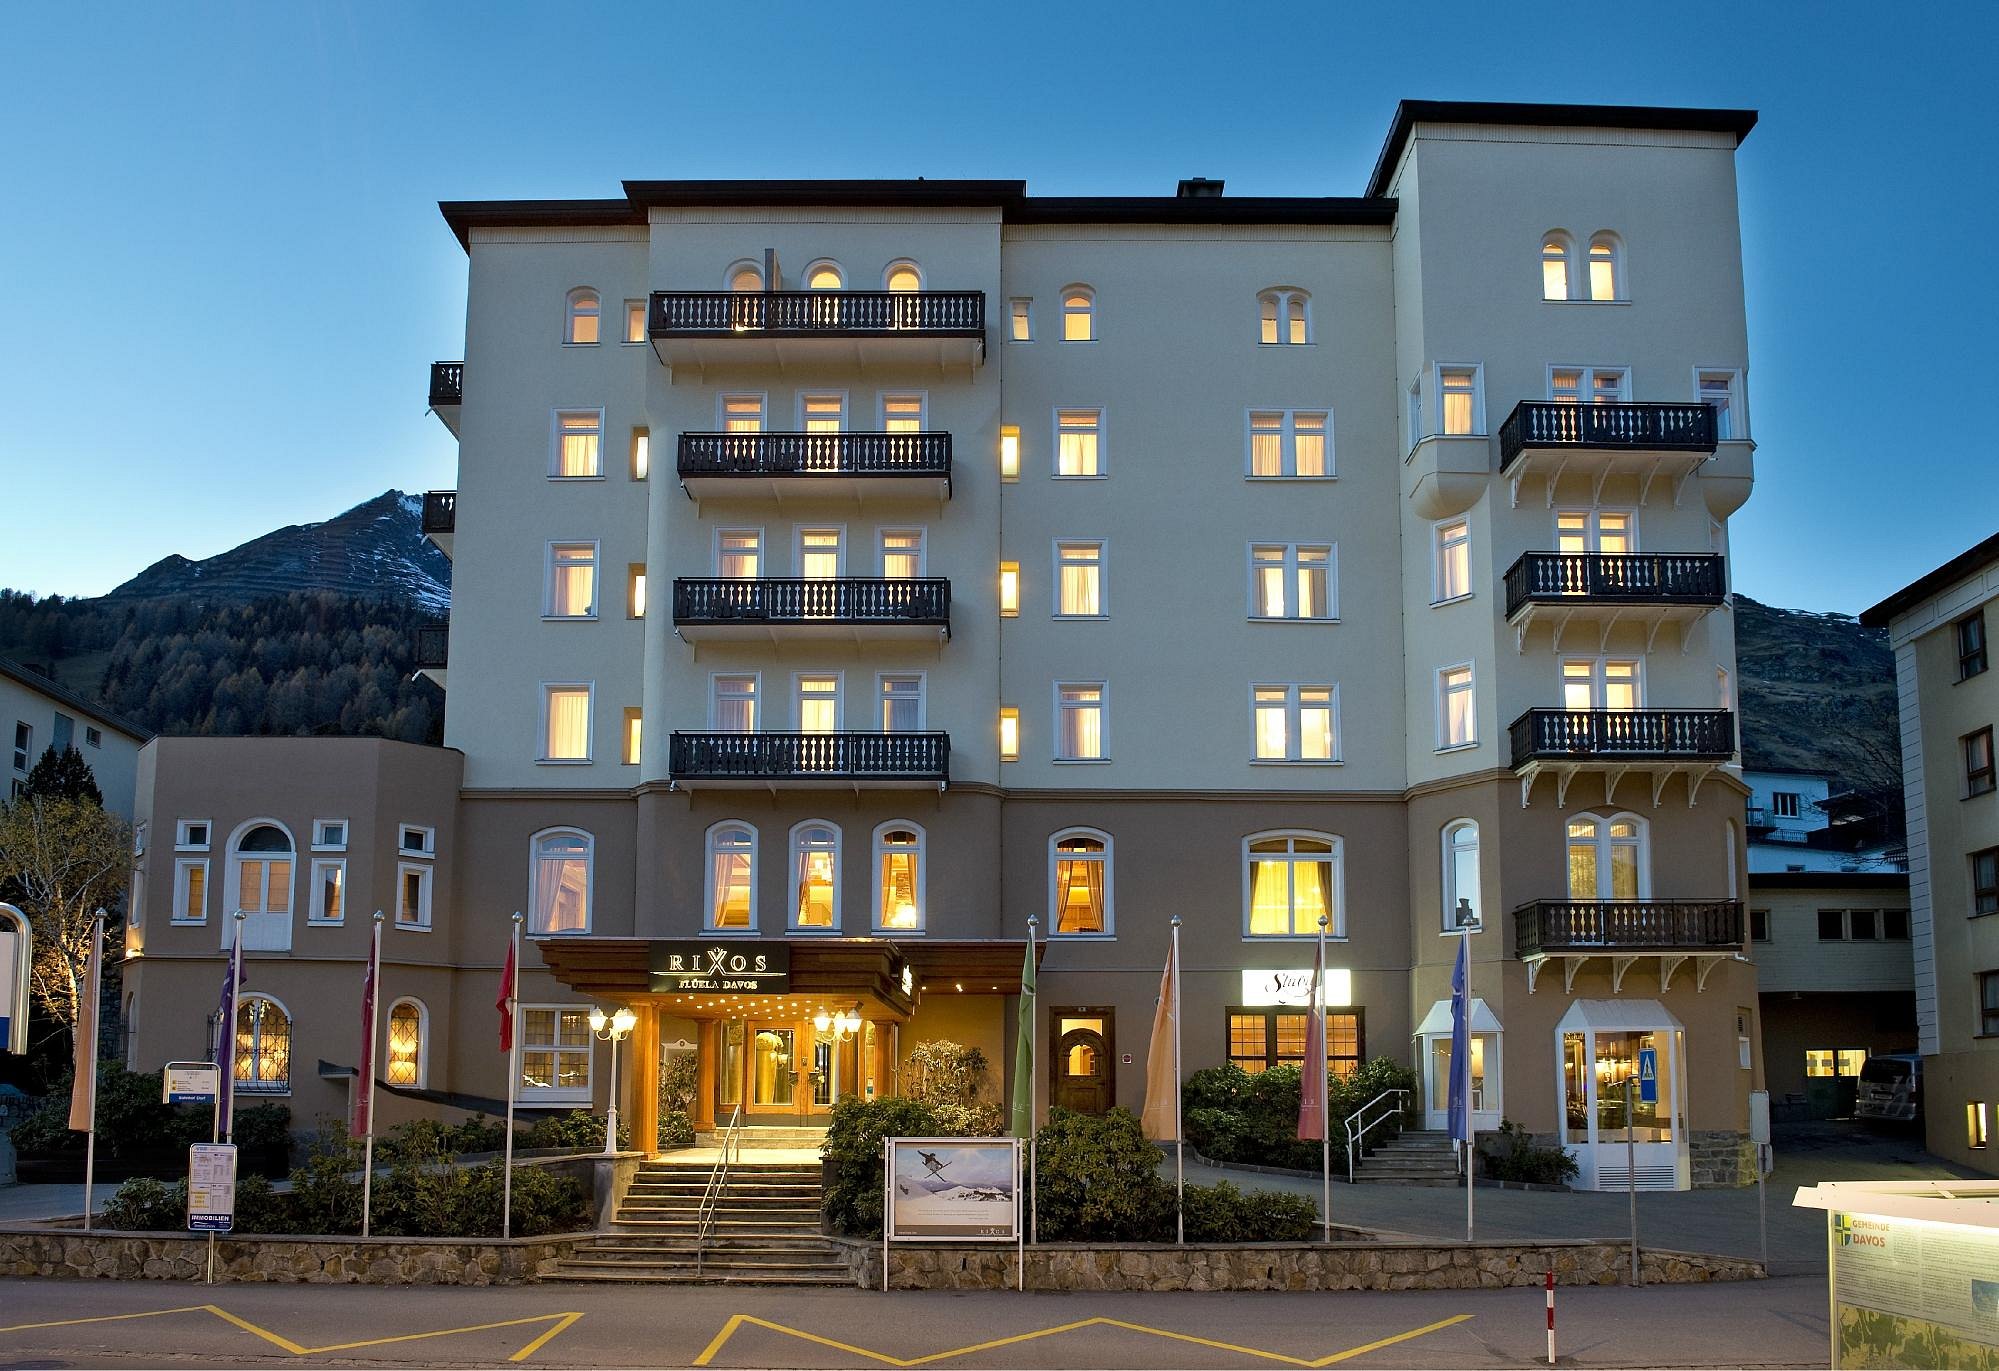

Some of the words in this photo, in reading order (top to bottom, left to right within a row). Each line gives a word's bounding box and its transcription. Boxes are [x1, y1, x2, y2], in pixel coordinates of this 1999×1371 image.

[669, 947, 767, 975] RIXOS
[722, 980, 758, 990] DAVOS
[191, 1214, 230, 1222] IMMOBILIEN
[1852, 1219, 1891, 1232] GEMEINDE
[1853, 1233, 1886, 1248] DAVOS
